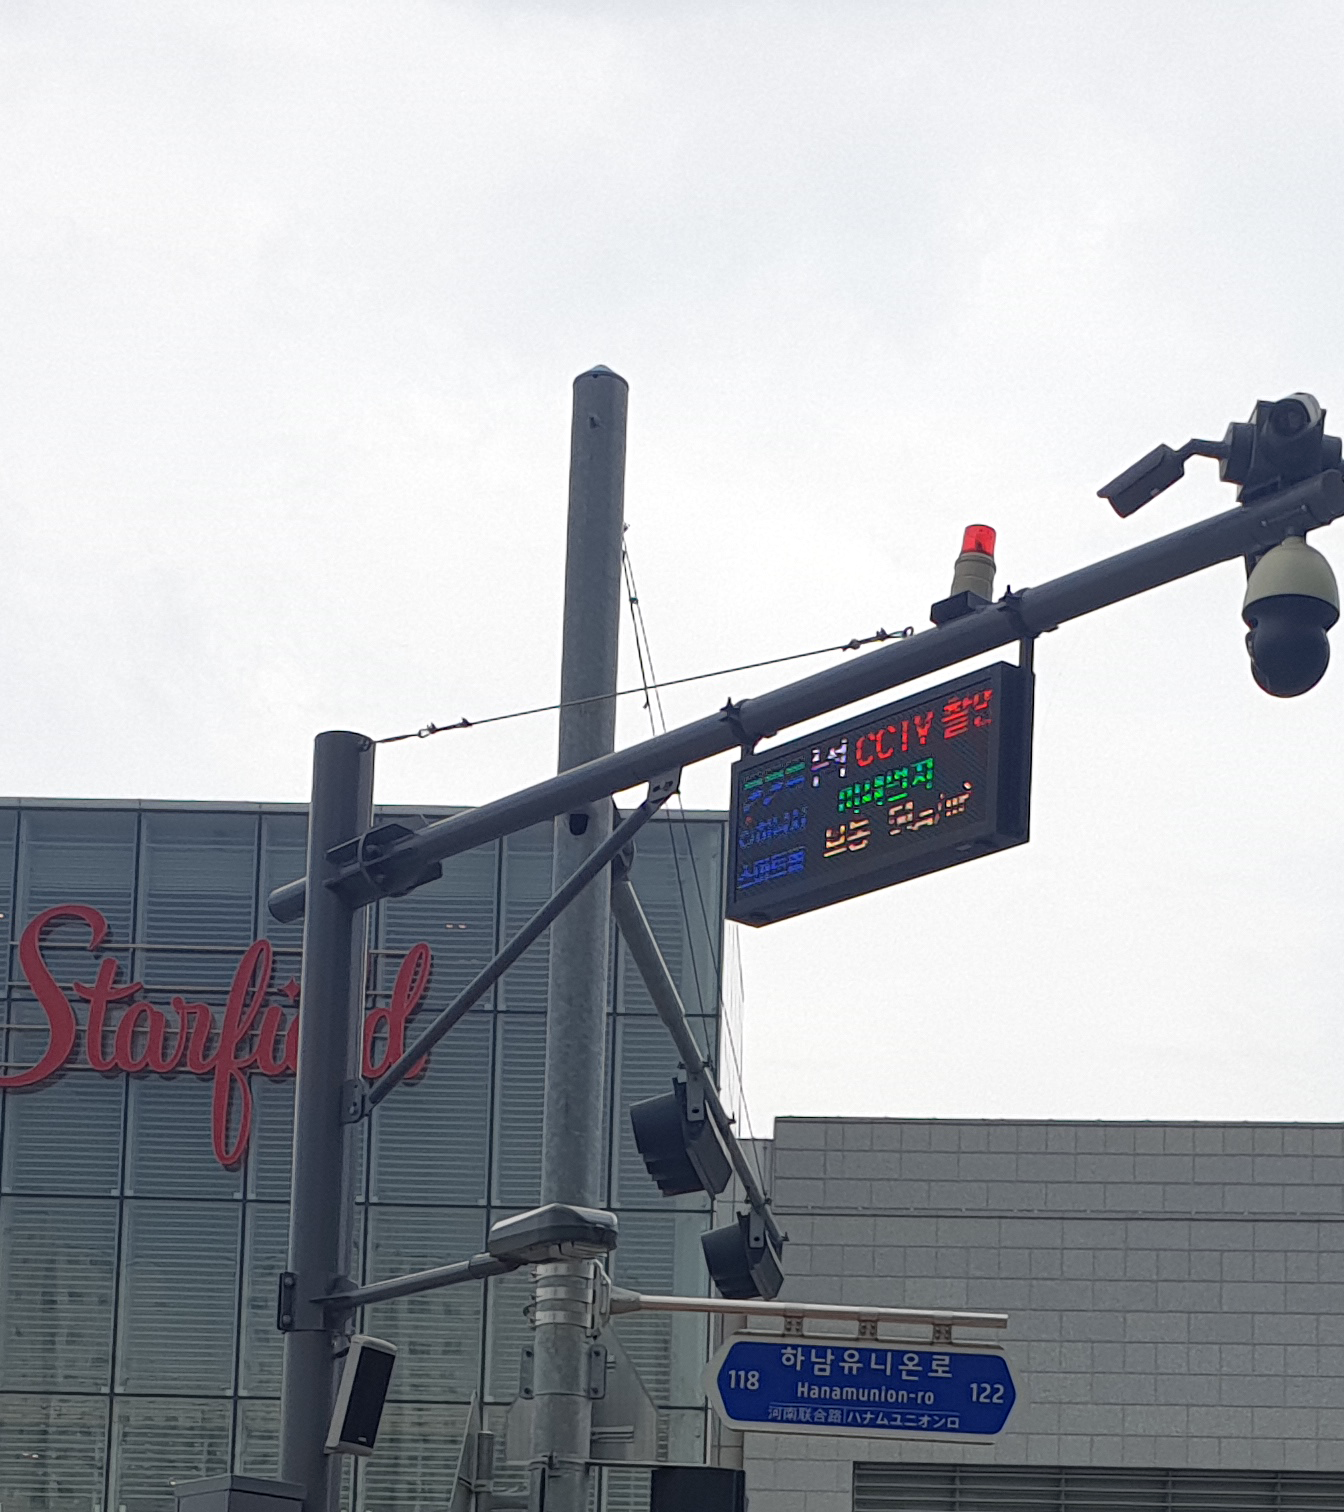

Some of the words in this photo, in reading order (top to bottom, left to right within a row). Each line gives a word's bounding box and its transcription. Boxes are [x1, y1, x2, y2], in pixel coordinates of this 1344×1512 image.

[728, 1369, 760, 1391] 118
[780, 1346, 954, 1381] 하남유니온로
[969, 1383, 1005, 1404] 122
[797, 1381, 935, 1406] Hanamunion-ro
